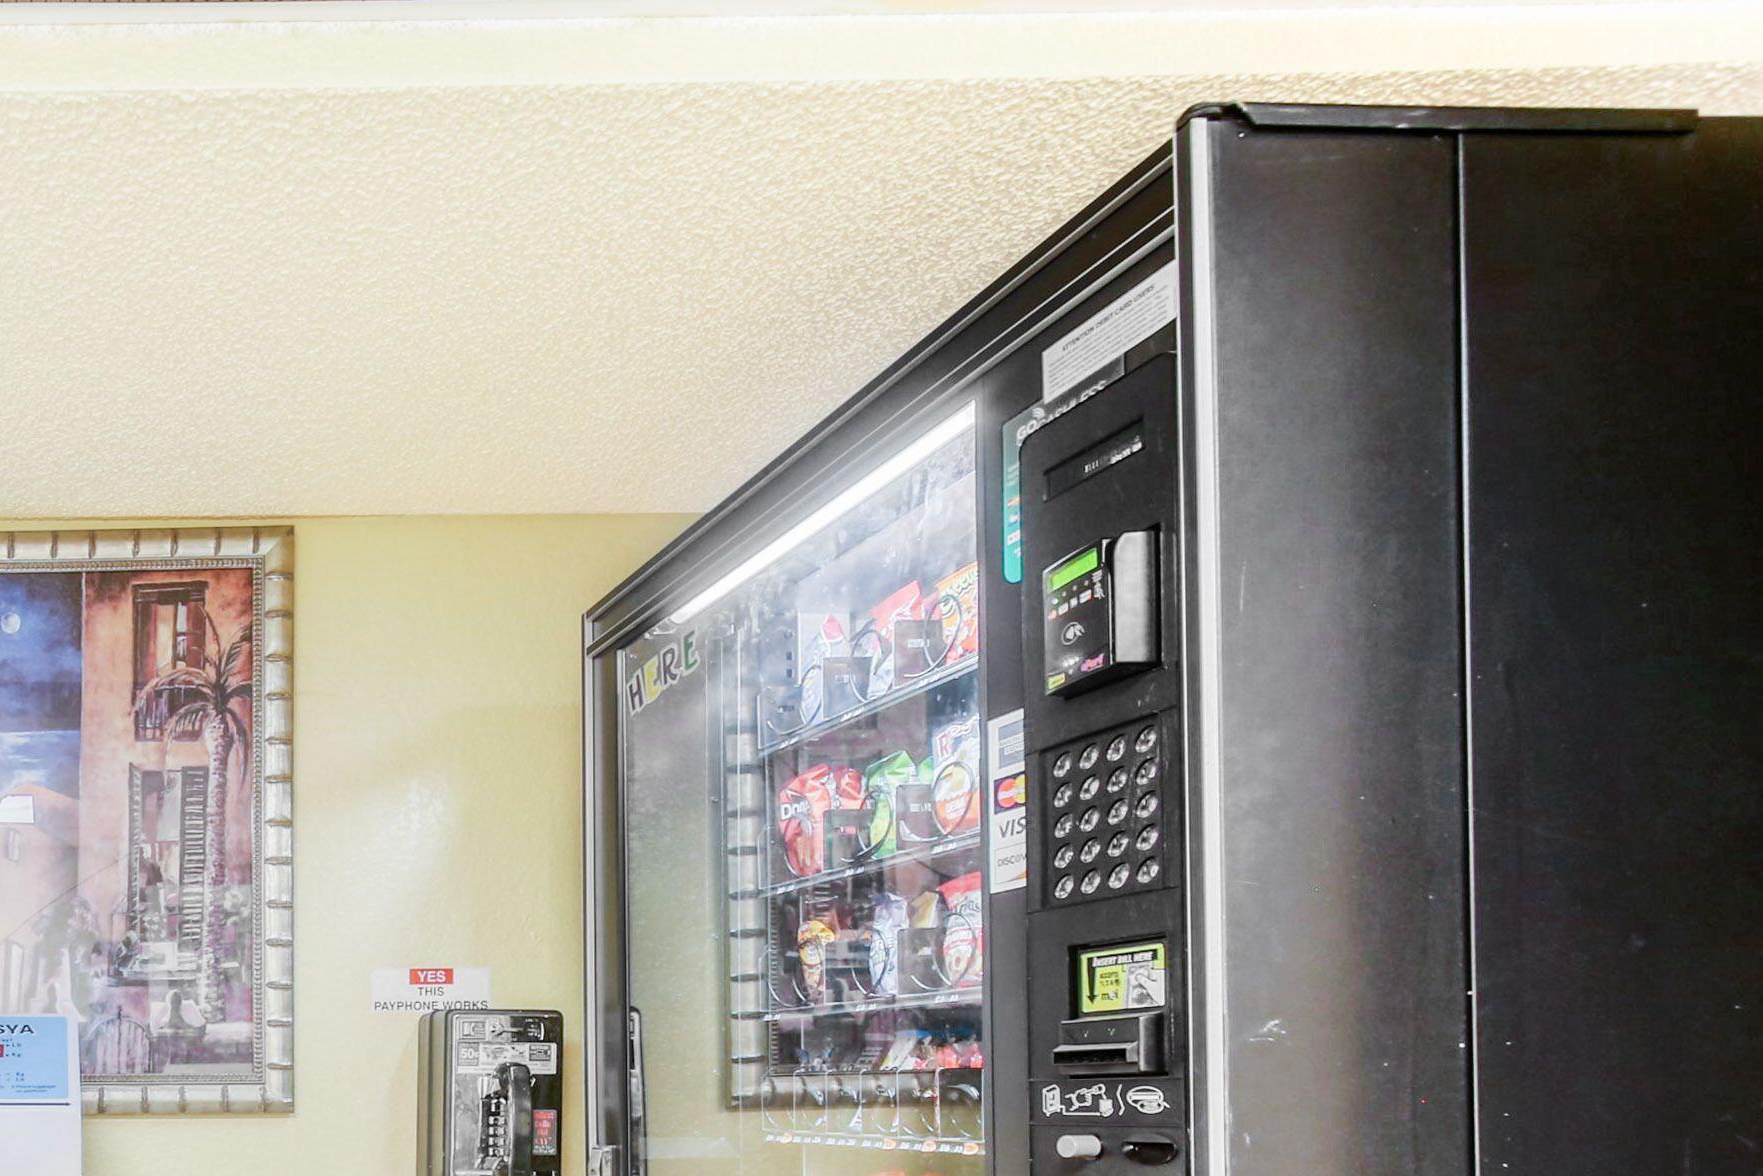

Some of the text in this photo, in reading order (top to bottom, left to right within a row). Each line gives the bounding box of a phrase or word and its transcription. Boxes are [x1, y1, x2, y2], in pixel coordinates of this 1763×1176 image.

[628, 629, 698, 713] HERE
[999, 817, 1027, 838] VIS
[997, 854, 1027, 868] DISCOV
[1092, 951, 1154, 967] INSERT BILL HERE
[418, 970, 446, 982] YES
[418, 987, 444, 997] THIS
[374, 1001, 489, 1011] PAYPHONE WORKS
